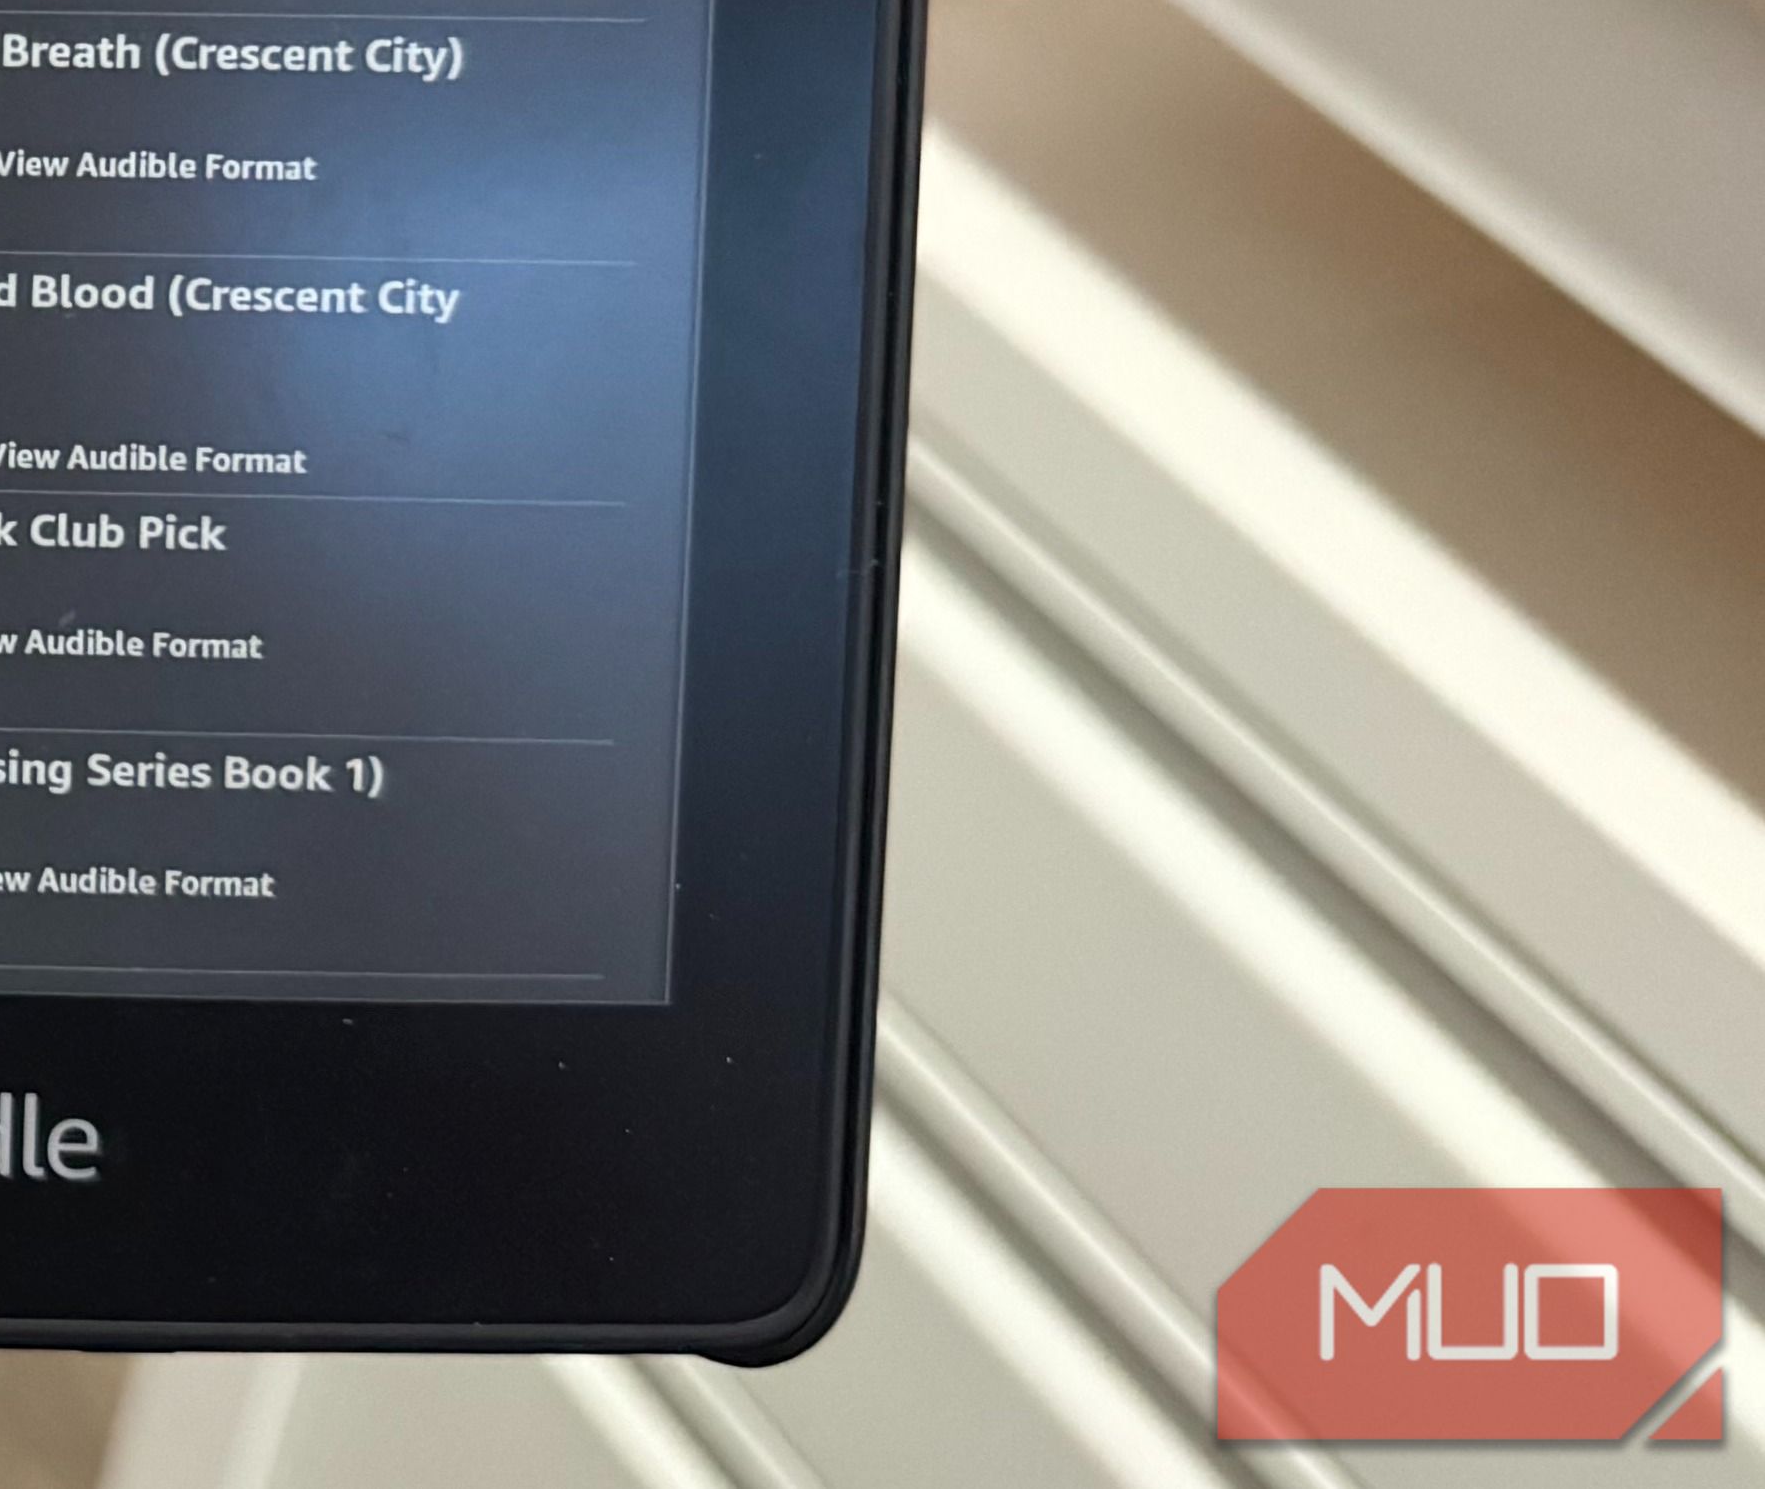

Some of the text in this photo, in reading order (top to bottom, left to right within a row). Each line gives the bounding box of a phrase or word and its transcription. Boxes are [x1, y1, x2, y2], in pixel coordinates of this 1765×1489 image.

[2, 33, 141, 69] Breath
[155, 32, 355, 77] (Crescent
[365, 36, 463, 82] City)
[75, 150, 197, 179] Audible
[205, 153, 318, 181] Format
[31, 273, 155, 310] Blood
[168, 274, 366, 317] (Crescent
[378, 278, 460, 324] City
[66, 442, 188, 472] Audible
[195, 446, 307, 474] Format
[30, 512, 125, 548] Club
[139, 513, 226, 551] Pick
[24, 628, 145, 657] Audible
[152, 632, 263, 660] Format
[87, 751, 212, 789] Series
[224, 755, 332, 791] Book
[345, 755, 384, 799] 1)
[37, 866, 157, 896] Audible
[164, 869, 275, 898] Format
